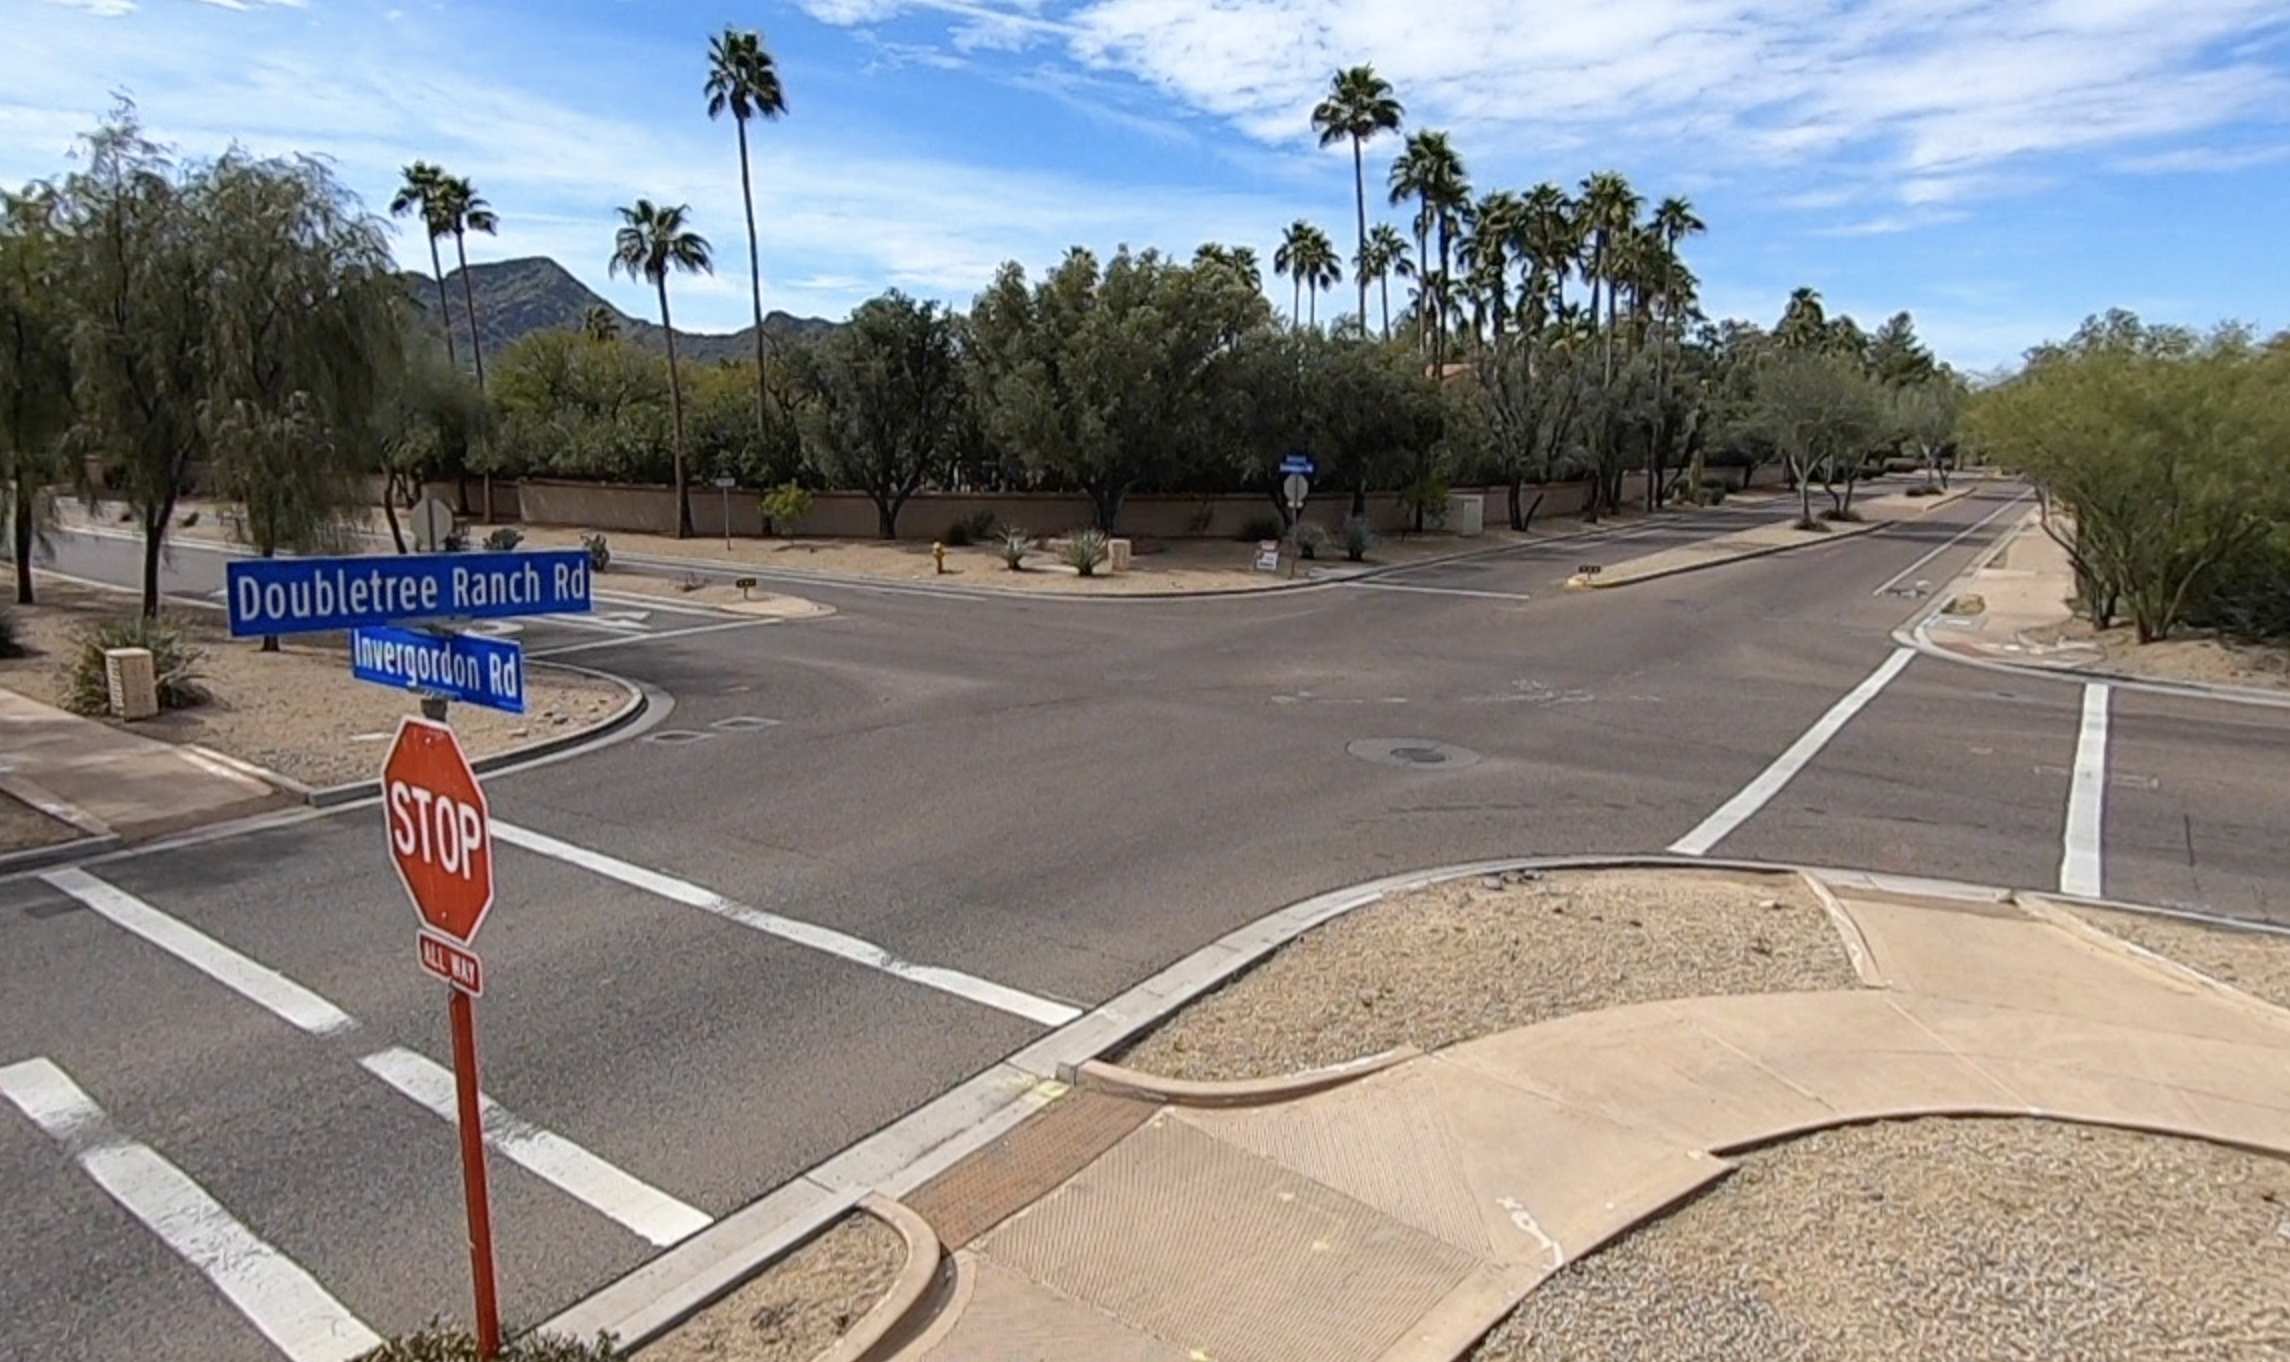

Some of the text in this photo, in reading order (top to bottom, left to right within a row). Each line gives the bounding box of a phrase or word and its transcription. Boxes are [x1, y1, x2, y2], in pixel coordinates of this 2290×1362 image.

[238, 558, 585, 622] Doubletree Ranch Rd
[353, 628, 518, 698] Invergordon Rd
[391, 780, 482, 880] STOP
[424, 941, 475, 985] ALL WAY
